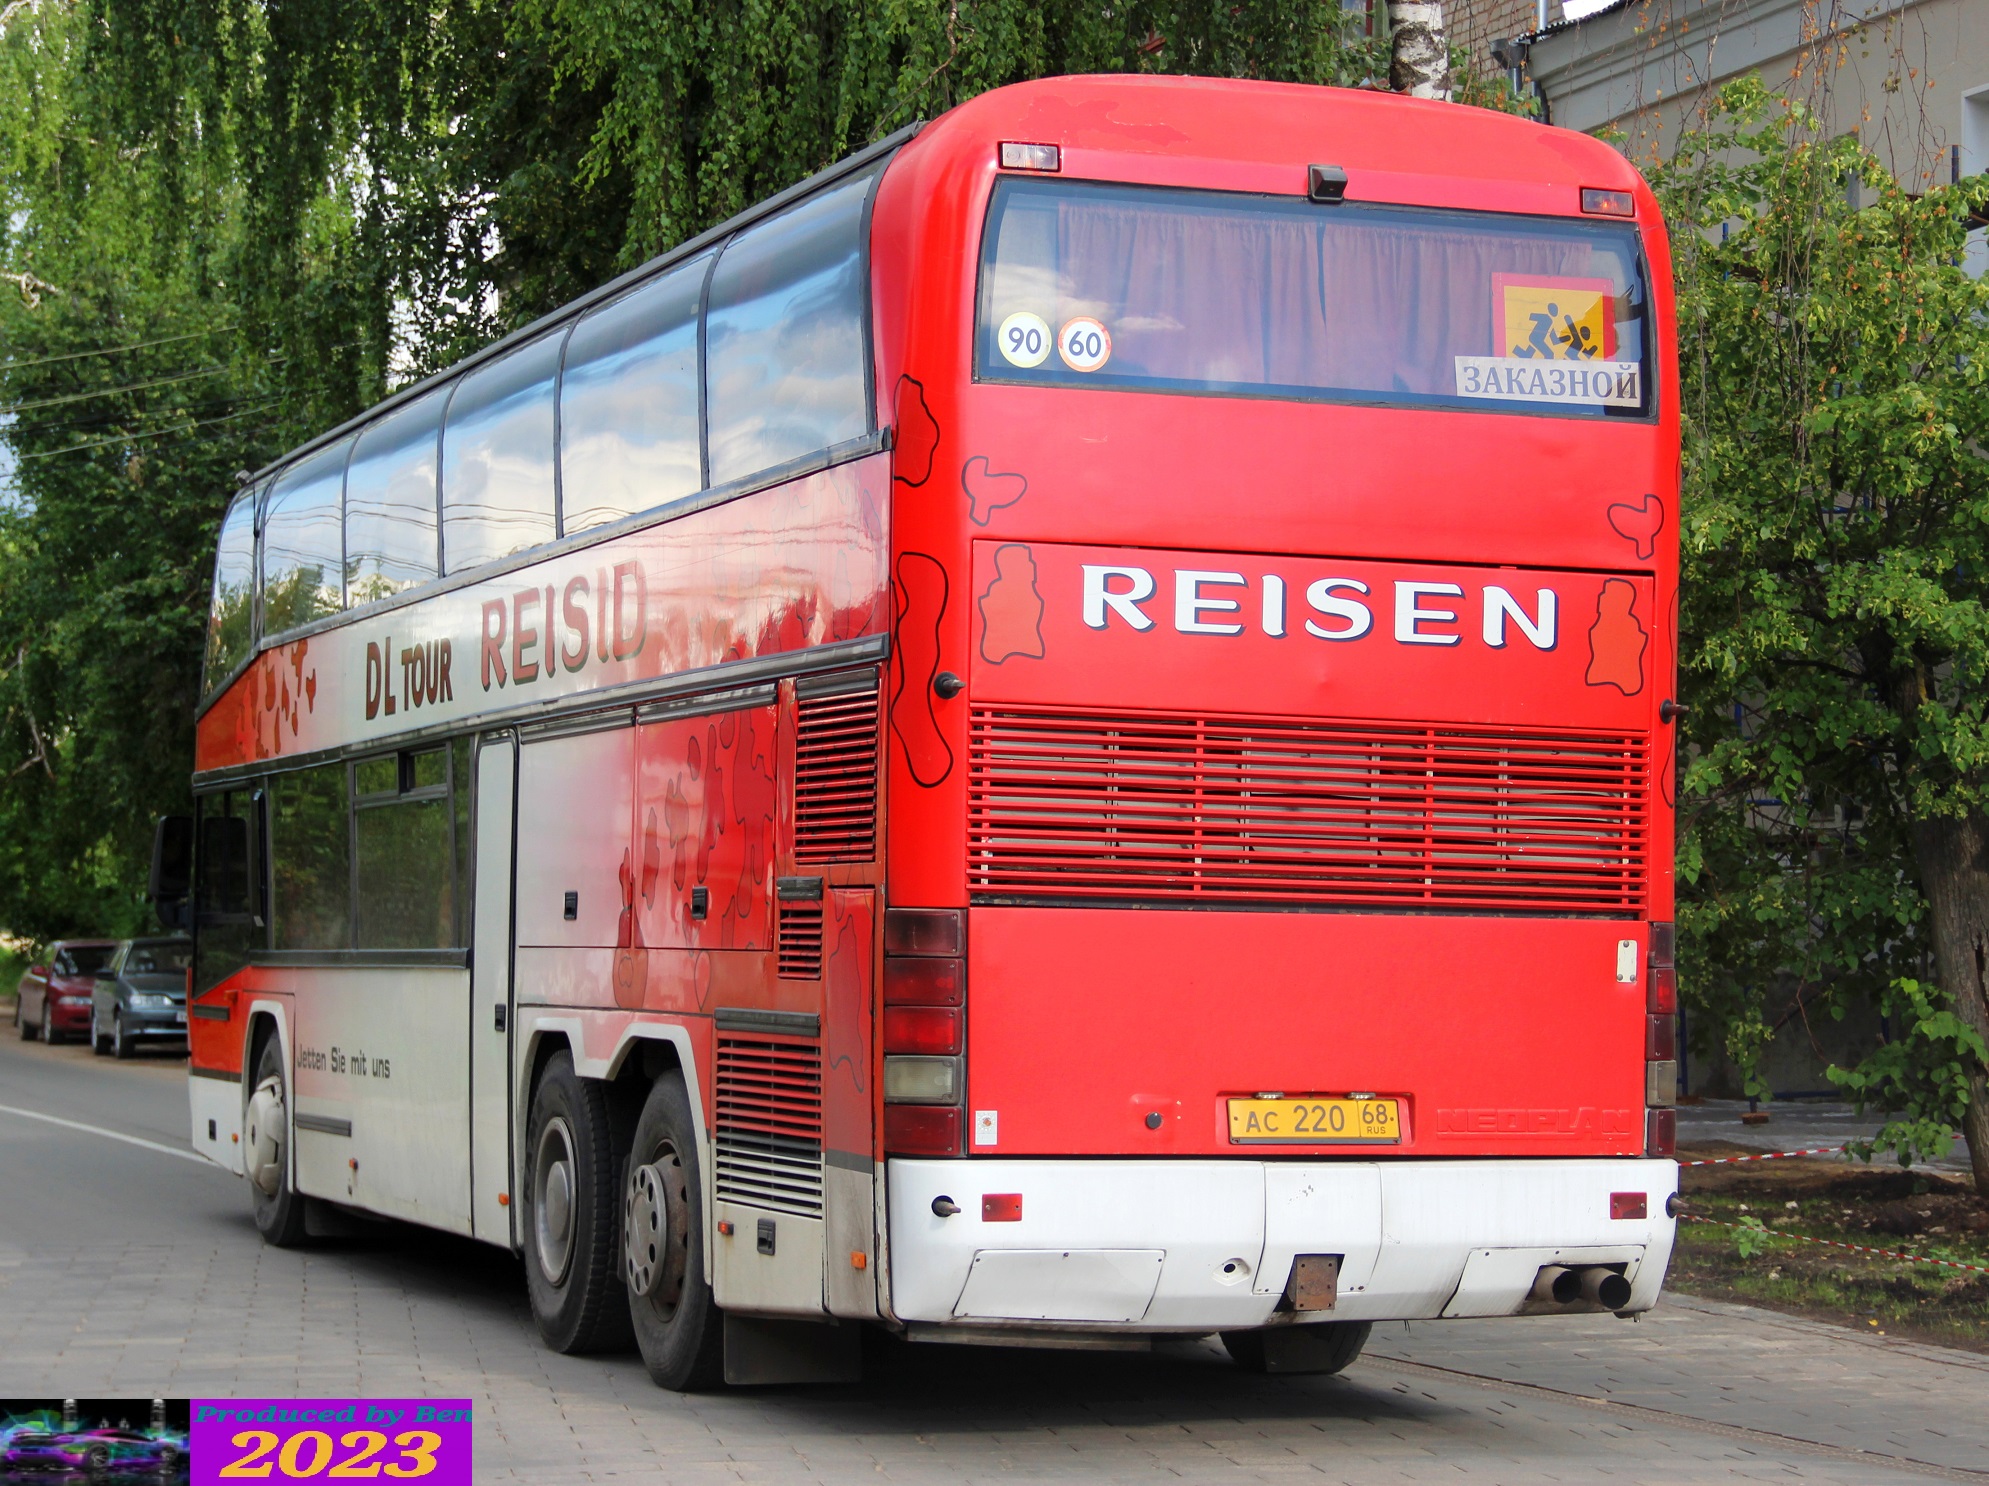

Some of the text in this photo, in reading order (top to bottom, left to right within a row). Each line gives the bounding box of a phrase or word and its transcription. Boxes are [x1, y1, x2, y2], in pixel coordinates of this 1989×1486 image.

[1008, 327, 1041, 354] 90
[1068, 331, 1101, 358] 60
[1463, 364, 1637, 399] ЗАКАЗНОЙ
[1080, 564, 1560, 652] REISEN
[365, 557, 648, 720] DL TOUR REISID
[331, 1046, 346, 1073] Sie
[351, 1050, 367, 1075] mit
[372, 1057, 391, 1078] uns
[1292, 1105, 1345, 1132] 220
[1362, 1103, 1388, 1124] 68
[1366, 1126, 1386, 1134] RUS
[1436, 1106, 1632, 1140] NEOPLAN
